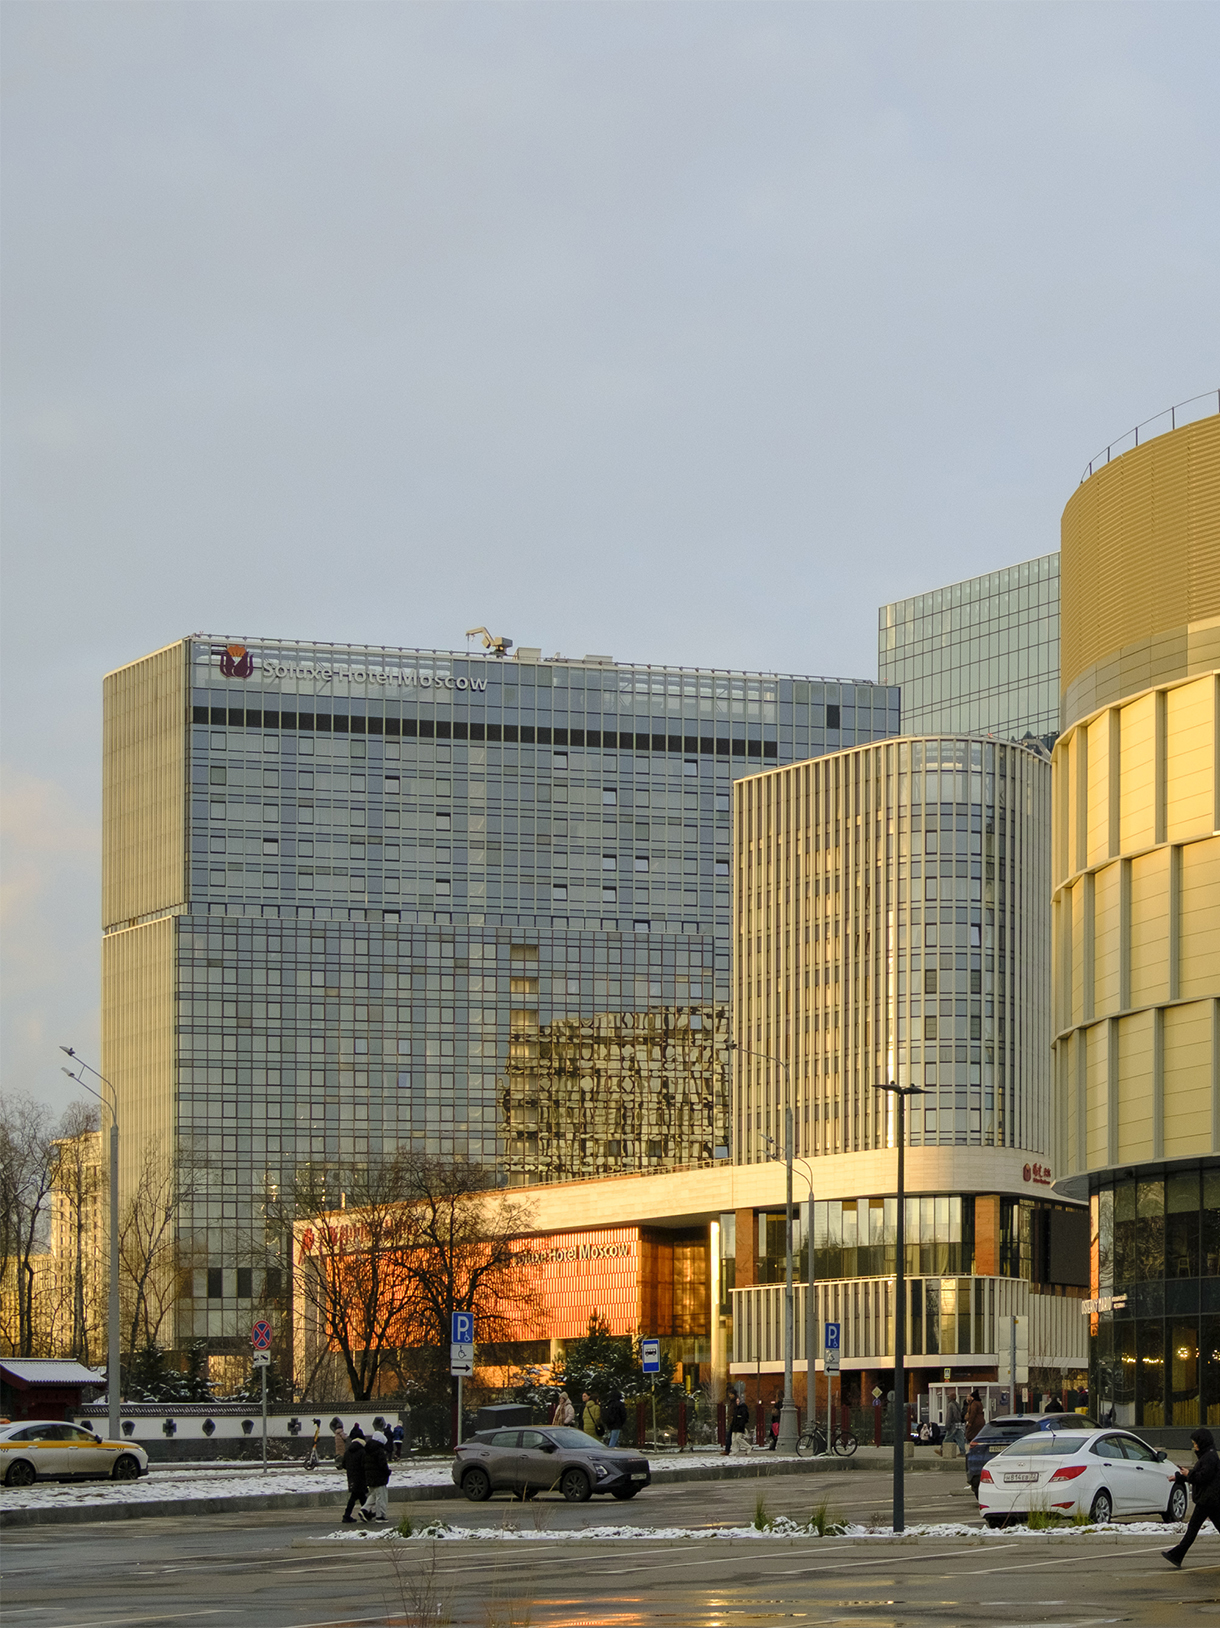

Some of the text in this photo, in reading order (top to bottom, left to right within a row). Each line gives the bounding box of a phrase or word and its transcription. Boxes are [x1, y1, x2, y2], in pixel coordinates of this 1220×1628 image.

[262, 660, 489, 692] Soluxe Hotel Moscow
[550, 1245, 578, 1263] Hotel
[578, 1243, 630, 1260] Moscow
[457, 1315, 470, 1341] P
[828, 1325, 838, 1347] P
